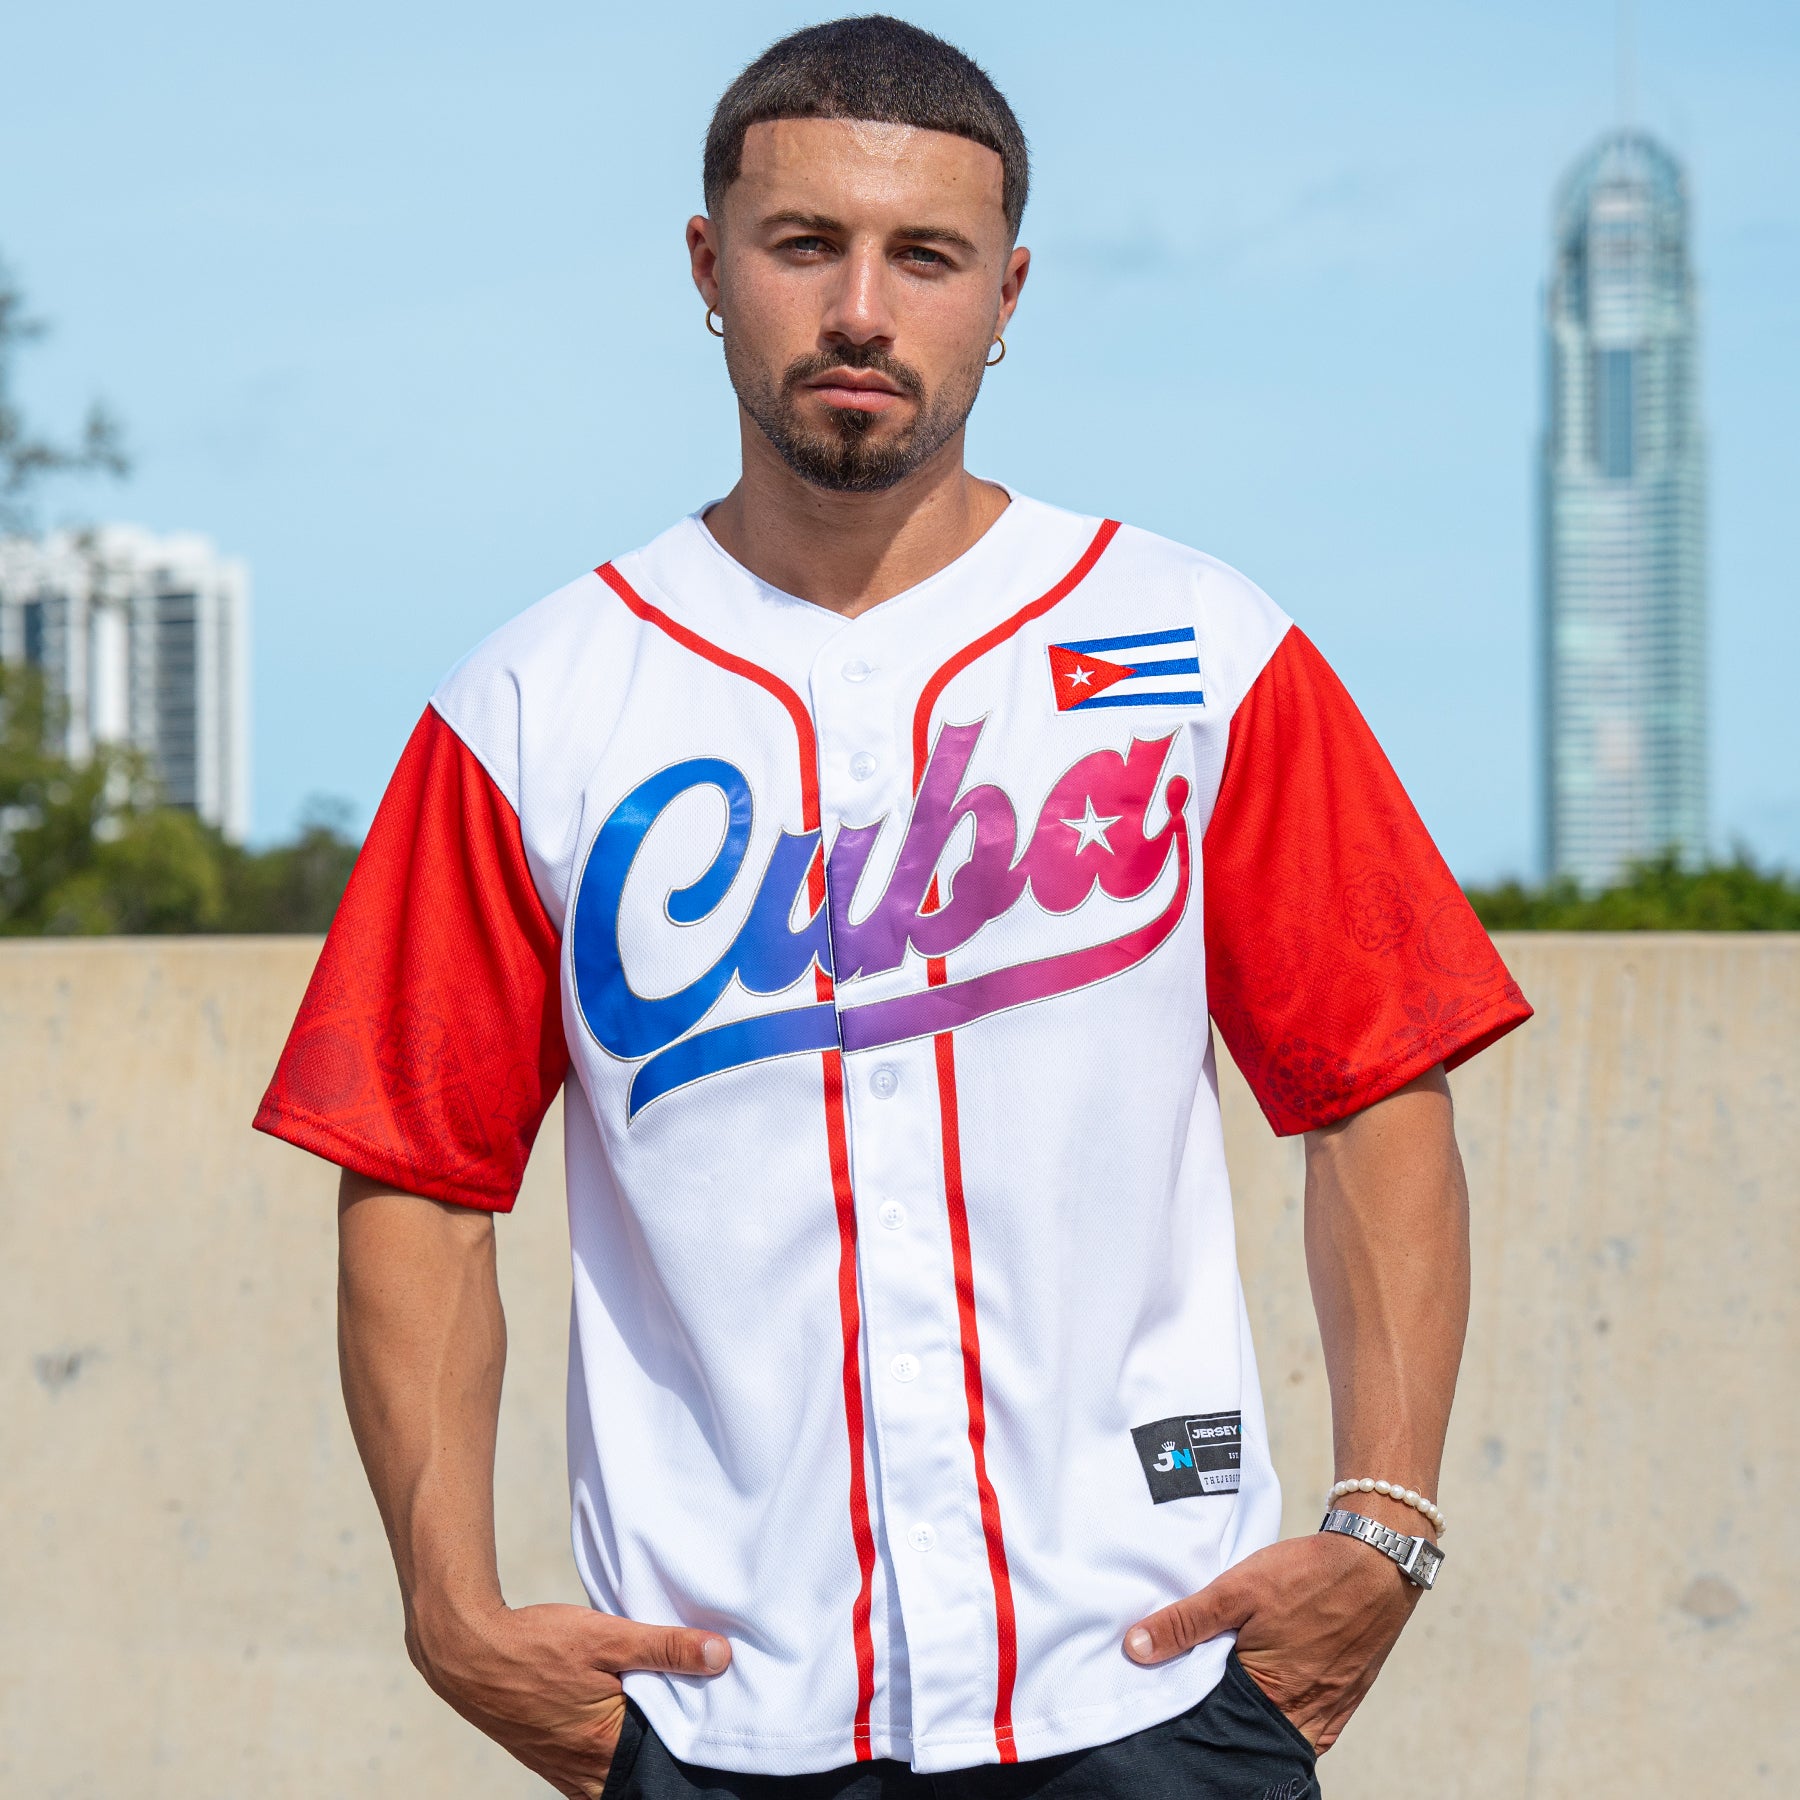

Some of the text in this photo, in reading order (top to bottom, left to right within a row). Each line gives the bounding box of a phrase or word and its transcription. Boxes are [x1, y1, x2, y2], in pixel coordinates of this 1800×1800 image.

[572, 712, 1192, 1127] Cuba
[1191, 1424, 1238, 1439] JERSEY
[1152, 1448, 1193, 1472] JN
